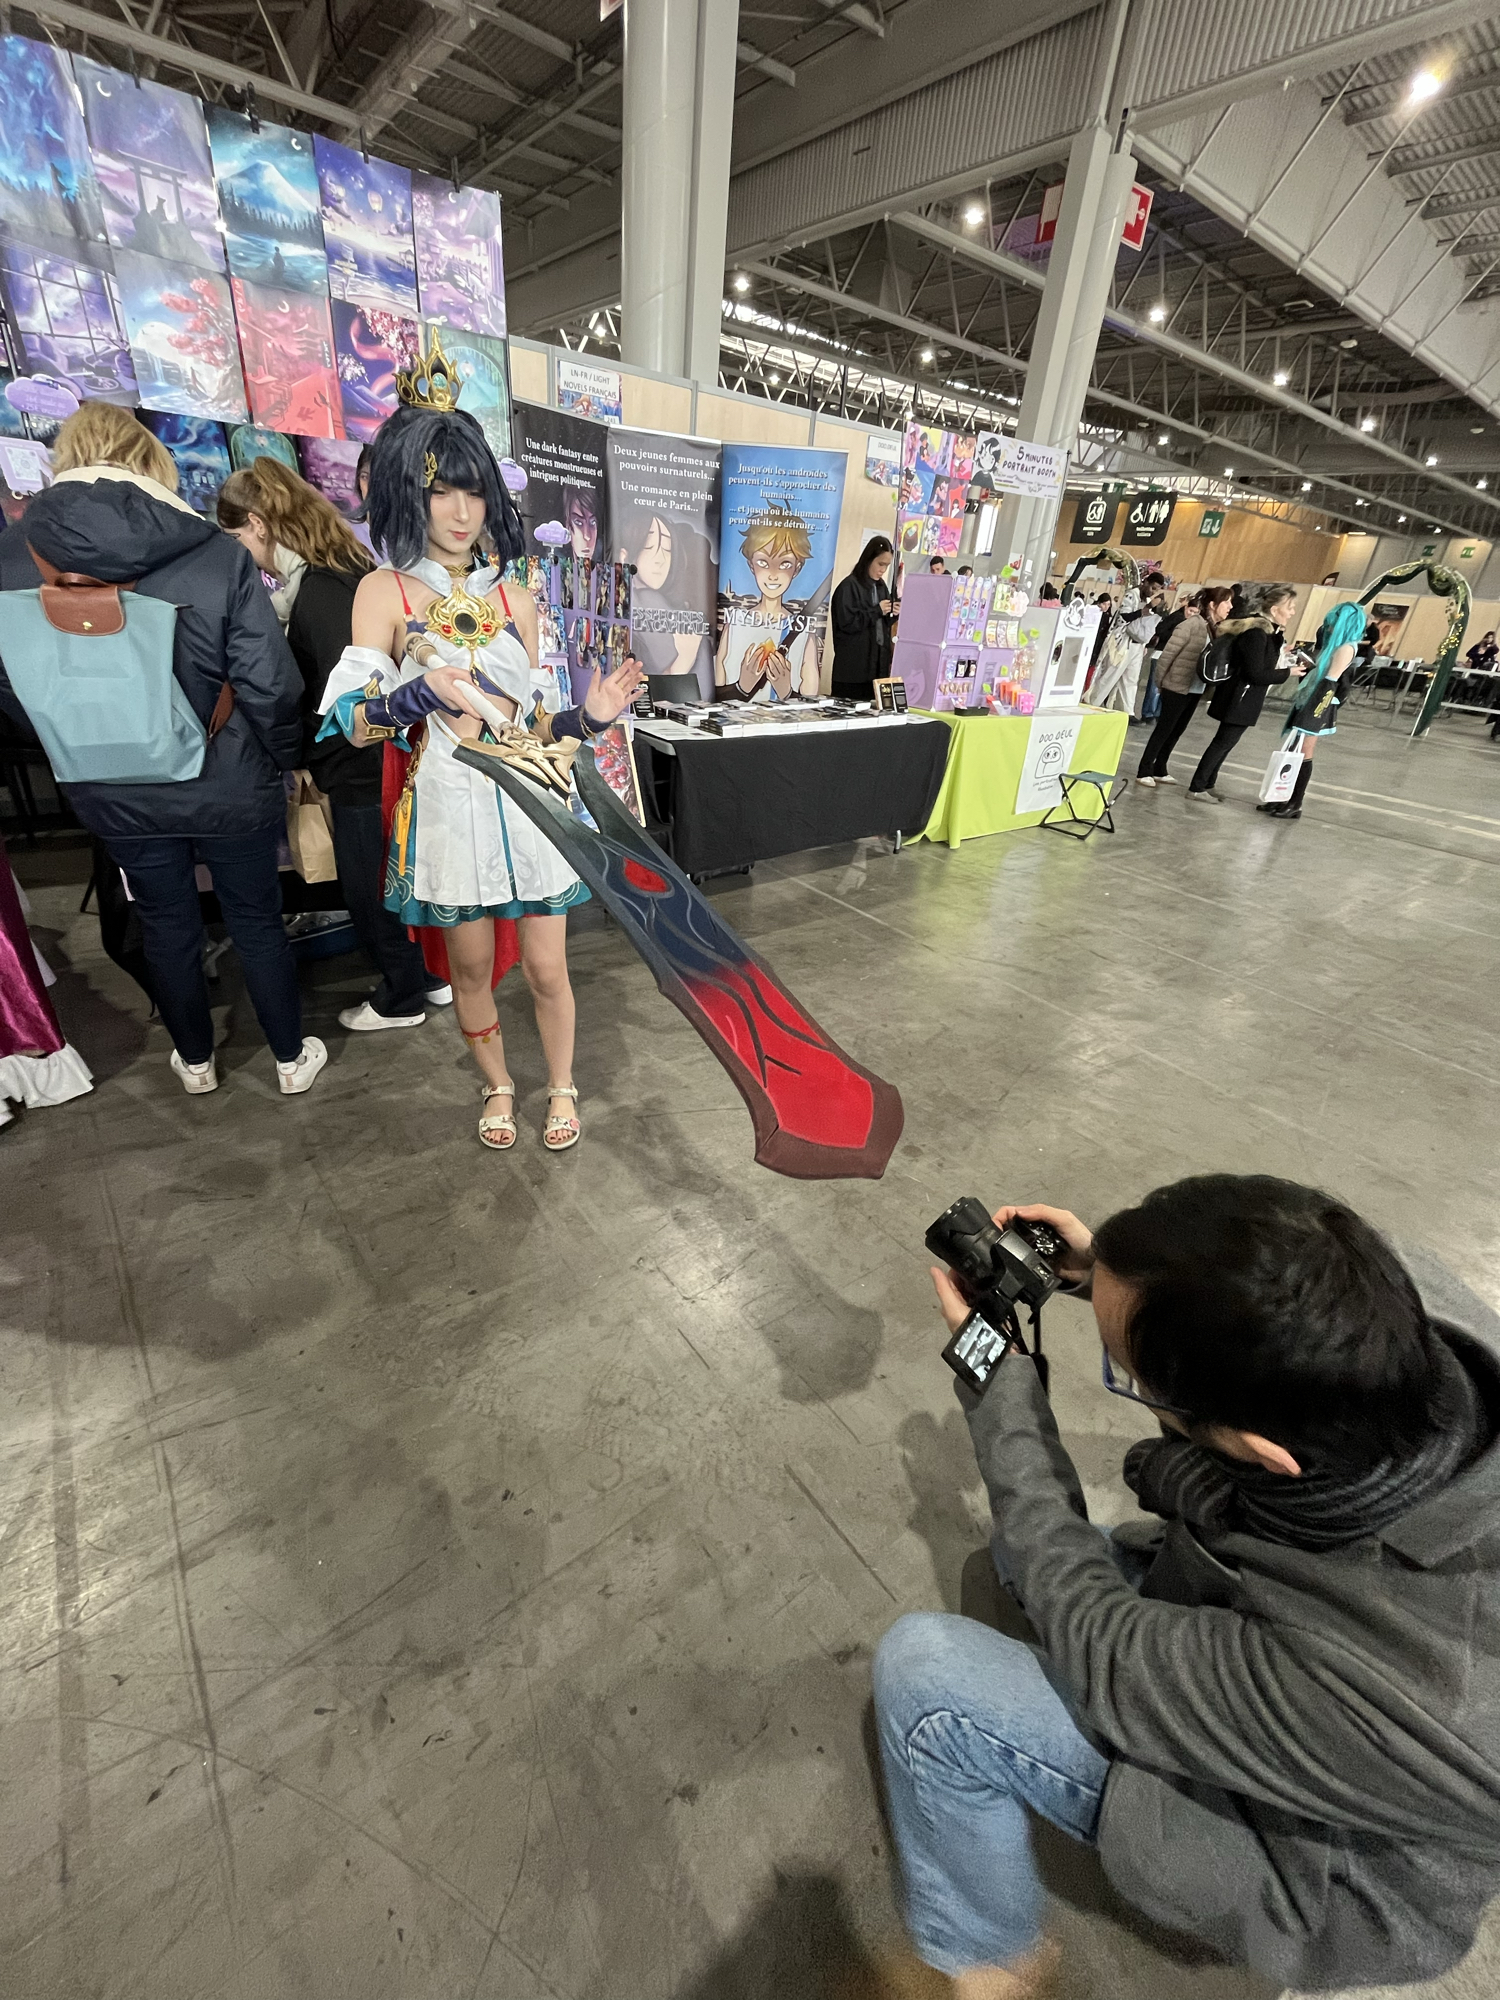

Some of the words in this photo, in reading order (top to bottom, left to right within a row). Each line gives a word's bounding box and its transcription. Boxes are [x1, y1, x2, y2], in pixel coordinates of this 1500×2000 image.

[570, 369, 588, 379] LN-FR
[594, 374, 610, 385] LIGHT
[564, 380, 587, 392] NOVELS
[589, 386, 616, 400] FRANÇAIS
[526, 437, 540, 450] Une
[542, 441, 557, 454] dark
[558, 445, 582, 461] fantasy
[582, 453, 599, 463] entre
[614, 445, 637, 456] Deux
[638, 449, 667, 461] jeunes
[669, 453, 703, 466] femmes
[705, 460, 720, 469] aux
[1017, 446, 1024, 460] 5
[1025, 453, 1052, 465] MINUTES
[521, 453, 552, 466] créatures
[554, 460, 596, 476] monstrueuses
[597, 469, 603, 477] et
[619, 462, 657, 473] pouvoirs
[660, 467, 715, 480] surnaturels...
[738, 464, 773, 475] Jusqu'où
[775, 466, 786, 475] les
[788, 468, 828, 479] androïdes
[1002, 460, 1036, 474] PORTRAIT
[1037, 468, 1056, 478] BOOTH
[530, 467, 559, 482] intrigues
[560, 474, 596, 489] politiques...
[729, 477, 773, 486] peuvent-ils
[775, 479, 821, 491] s'approcher
[823, 482, 836, 491] des
[621, 481, 638, 491] Une
[641, 485, 677, 496] romance
[692, 491, 712, 501] plein
[760, 489, 802, 501] humains...
[634, 498, 656, 506] cœur
[658, 499, 667, 508] de
[670, 500, 698, 511] Paris...
[747, 505, 780, 516] jusqu'où
[782, 508, 793, 516] les
[794, 509, 830, 520] humains
[973, 503, 979, 512] 7
[729, 517, 772, 527] peuvent-ils
[784, 520, 823, 531] détruire...
[824, 524, 829, 532] ?
[646, 608, 704, 624] SPECTRES
[723, 607, 817, 633] MYDRIASE
[634, 618, 651, 631] LA
[653, 620, 710, 635] CAPITALE
